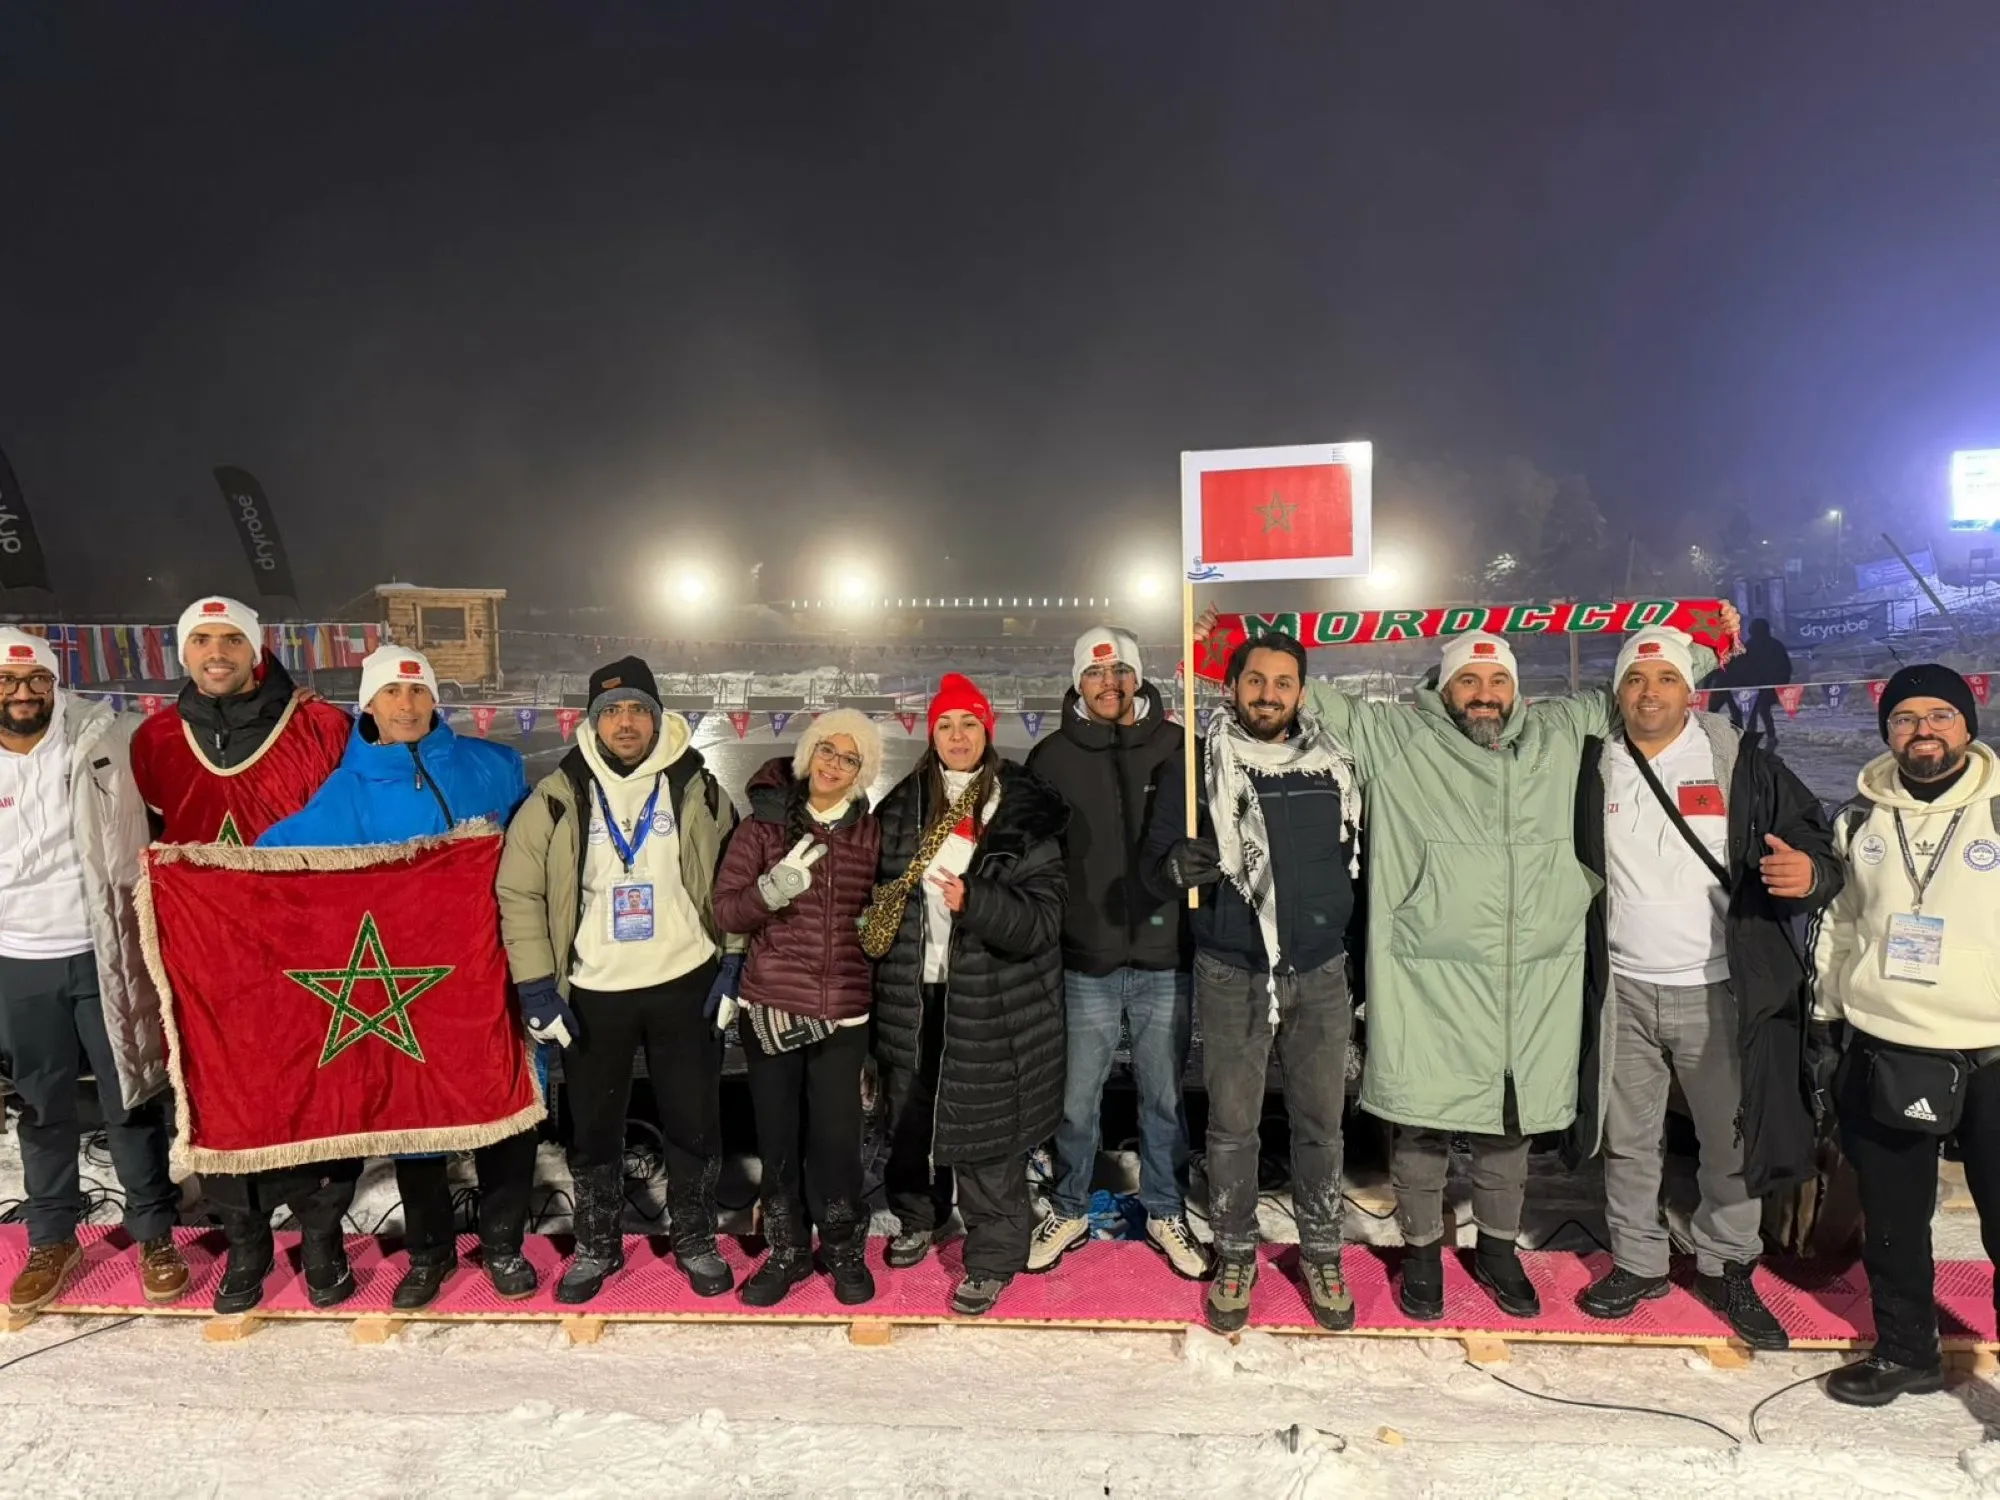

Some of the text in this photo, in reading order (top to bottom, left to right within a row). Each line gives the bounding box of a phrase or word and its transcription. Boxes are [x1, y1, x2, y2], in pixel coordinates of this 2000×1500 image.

[238, 494, 275, 570] dryrobe
[1239, 600, 1679, 645] MOROCCO
[1800, 619, 1869, 639] dryrobe
[1904, 1108, 1937, 1121] adidas
